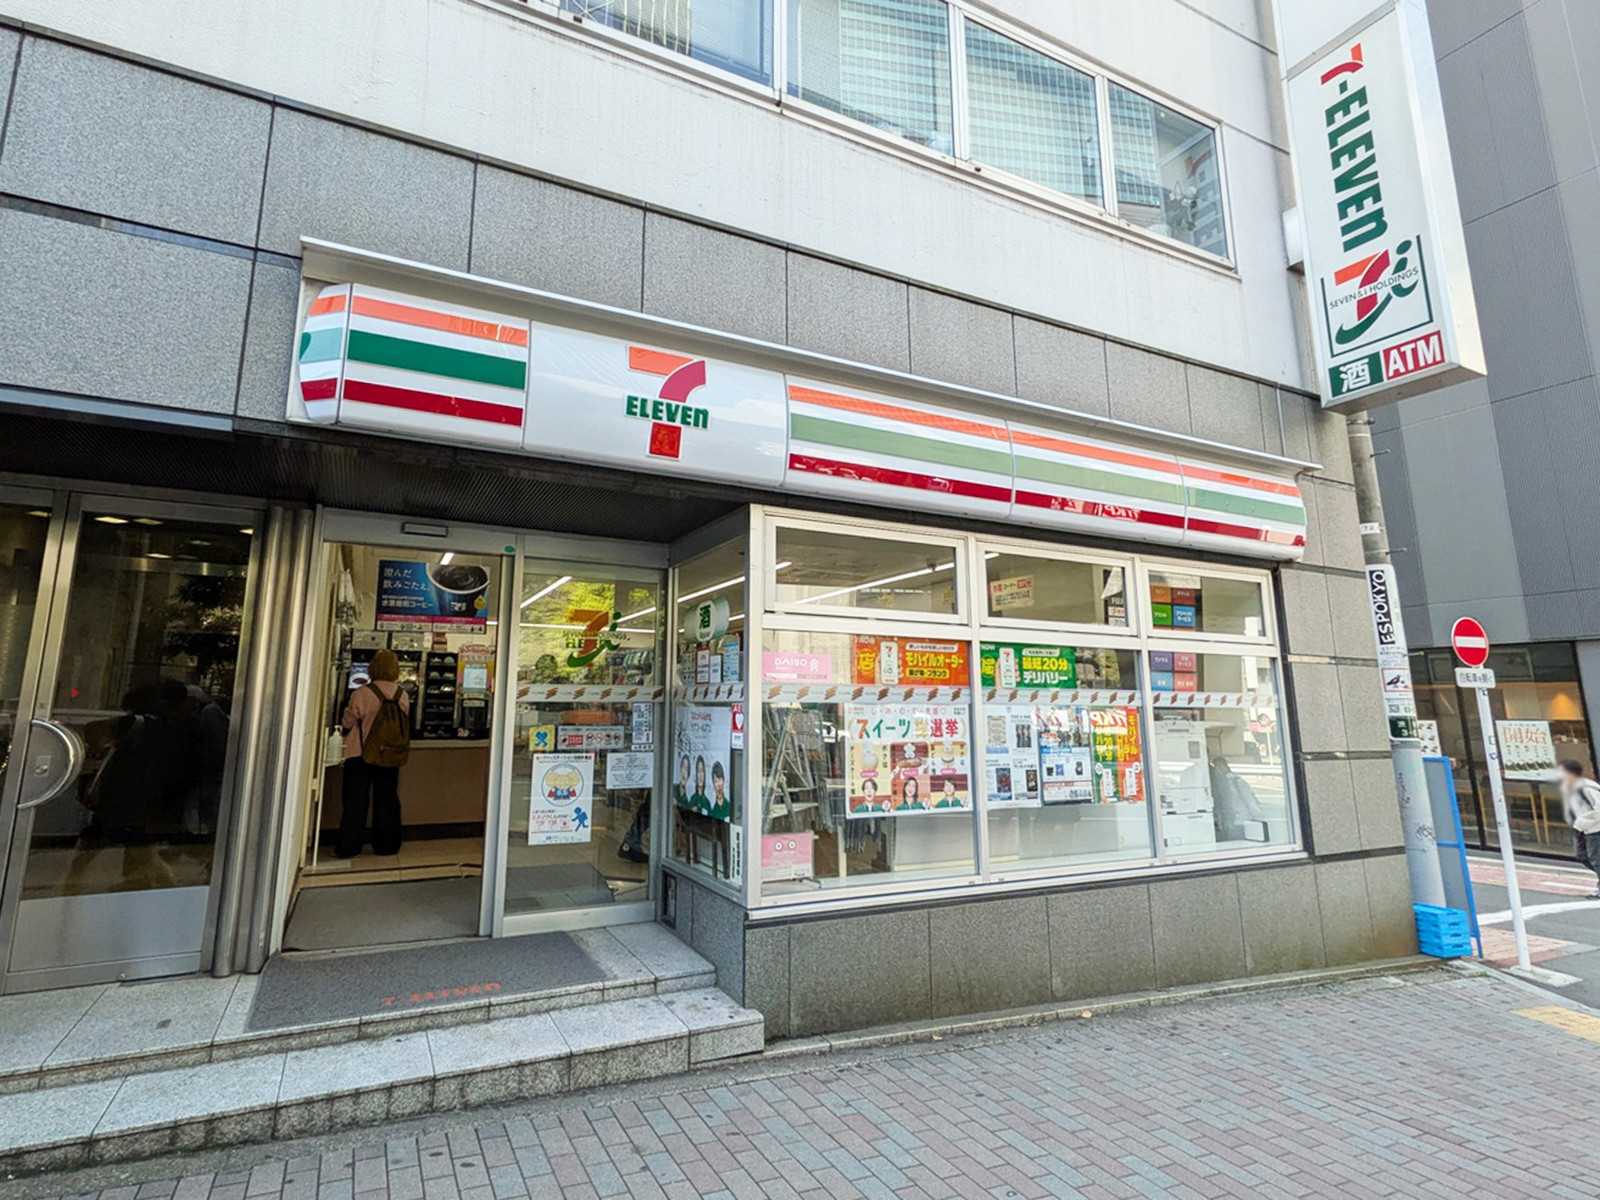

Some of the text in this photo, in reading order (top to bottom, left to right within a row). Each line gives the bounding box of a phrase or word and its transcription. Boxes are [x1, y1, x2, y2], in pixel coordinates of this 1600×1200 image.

[1369, 266, 1419, 293] HOLDINGS
[1388, 334, 1442, 377] ATM
[1338, 357, 1371, 393] 酒
[1372, 571, 1394, 643] ESPOKYO
[775, 657, 807, 666] DAISO
[905, 651, 964, 668] モバイルオーダー
[1022, 656, 1068, 671] 最短20分
[1023, 671, 1068, 684] デリバリー
[1502, 727, 1547, 745] 開始
